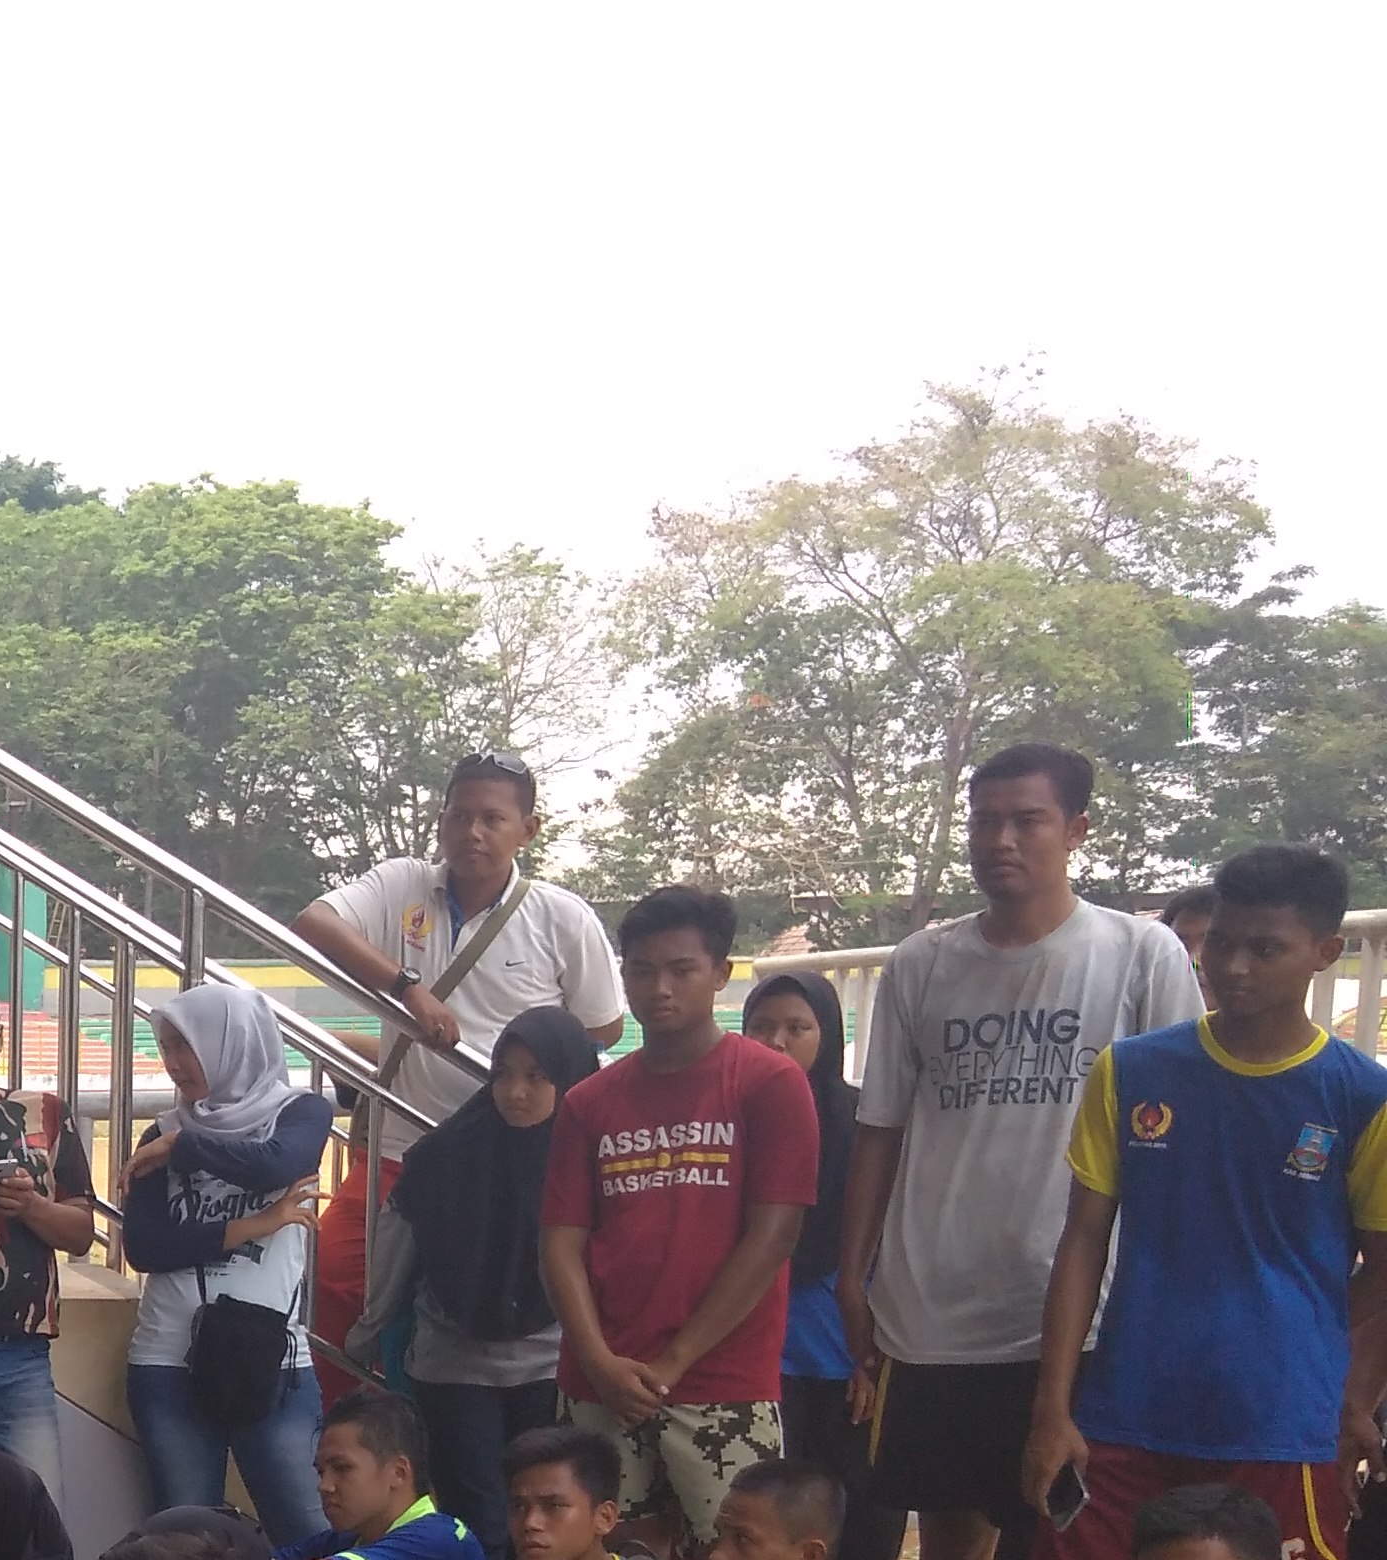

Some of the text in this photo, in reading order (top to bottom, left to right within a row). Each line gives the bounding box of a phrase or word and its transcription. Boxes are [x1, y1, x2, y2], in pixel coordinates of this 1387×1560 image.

[943, 1008, 1081, 1054] DOING
[929, 1045, 1099, 1086] EVERYTHING
[939, 1077, 1080, 1111] DIFFERENT
[598, 1120, 735, 1159] ASSASSIN
[602, 1166, 730, 1198] BASKETBALL
